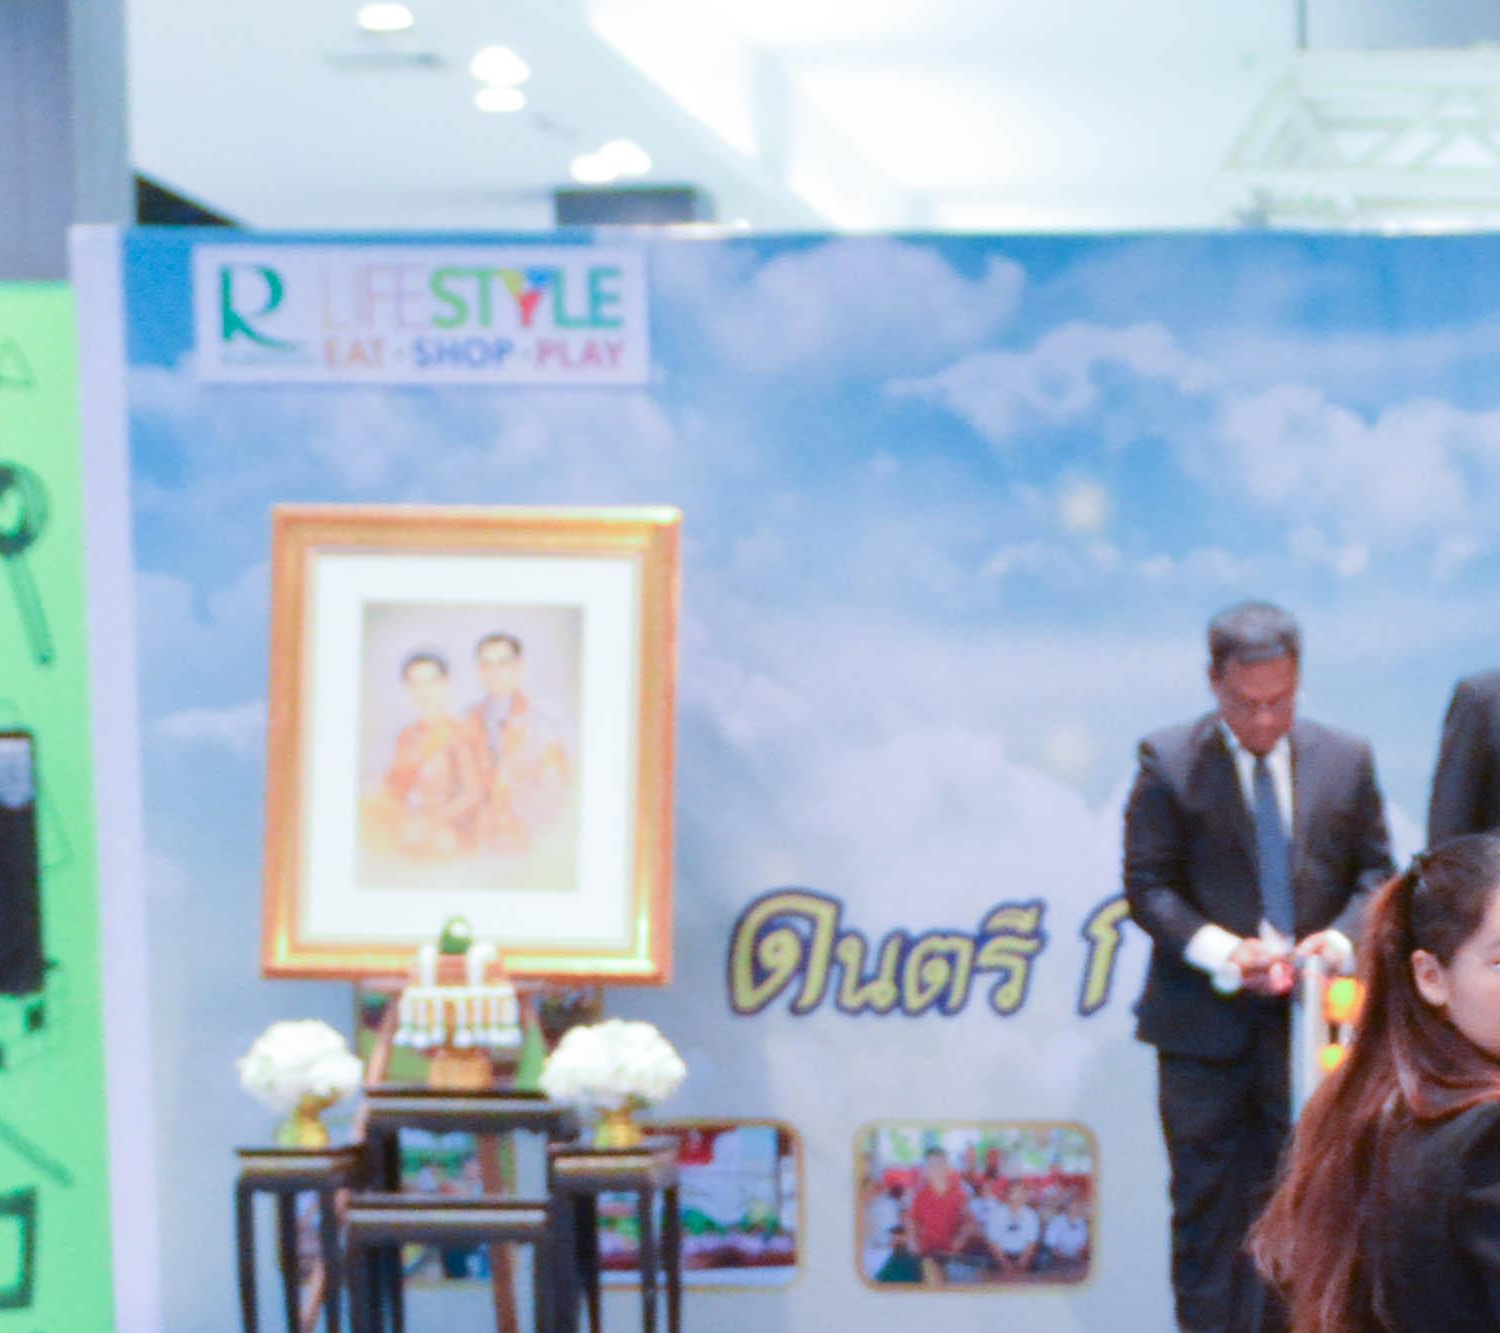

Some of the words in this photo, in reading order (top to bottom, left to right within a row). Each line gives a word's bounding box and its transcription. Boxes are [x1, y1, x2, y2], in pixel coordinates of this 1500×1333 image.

[319, 265, 627, 330] LIFESTYLE
[323, 338, 386, 369] EAT
[411, 337, 514, 370] SHOP
[536, 338, 627, 370] PLAY
[727, 886, 1048, 1017] ดนตรี
